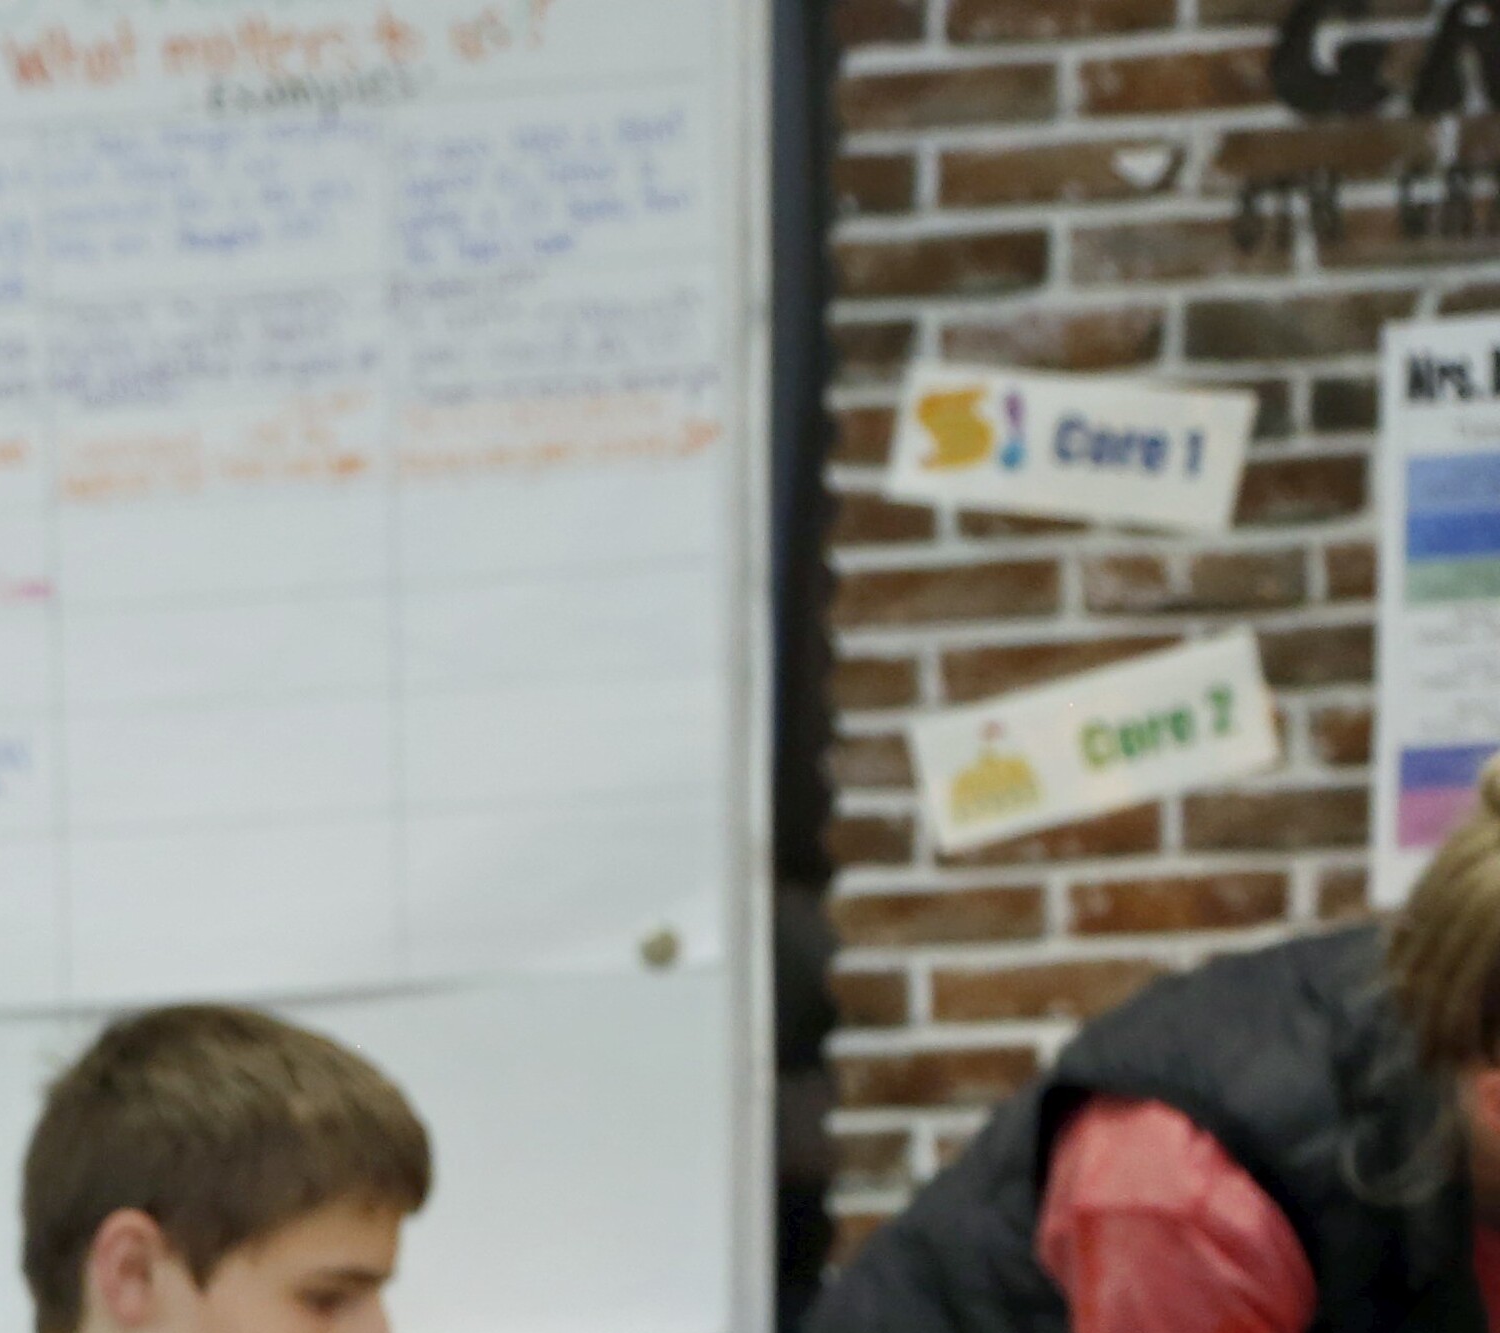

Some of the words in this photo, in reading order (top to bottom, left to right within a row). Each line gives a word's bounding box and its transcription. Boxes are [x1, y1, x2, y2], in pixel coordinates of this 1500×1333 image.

[1406, 354, 1476, 404] Mrs.
[1054, 410, 1169, 473] Core
[1184, 426, 1206, 477] 1
[1079, 704, 1194, 771] Core
[1207, 682, 1237, 737] 2
